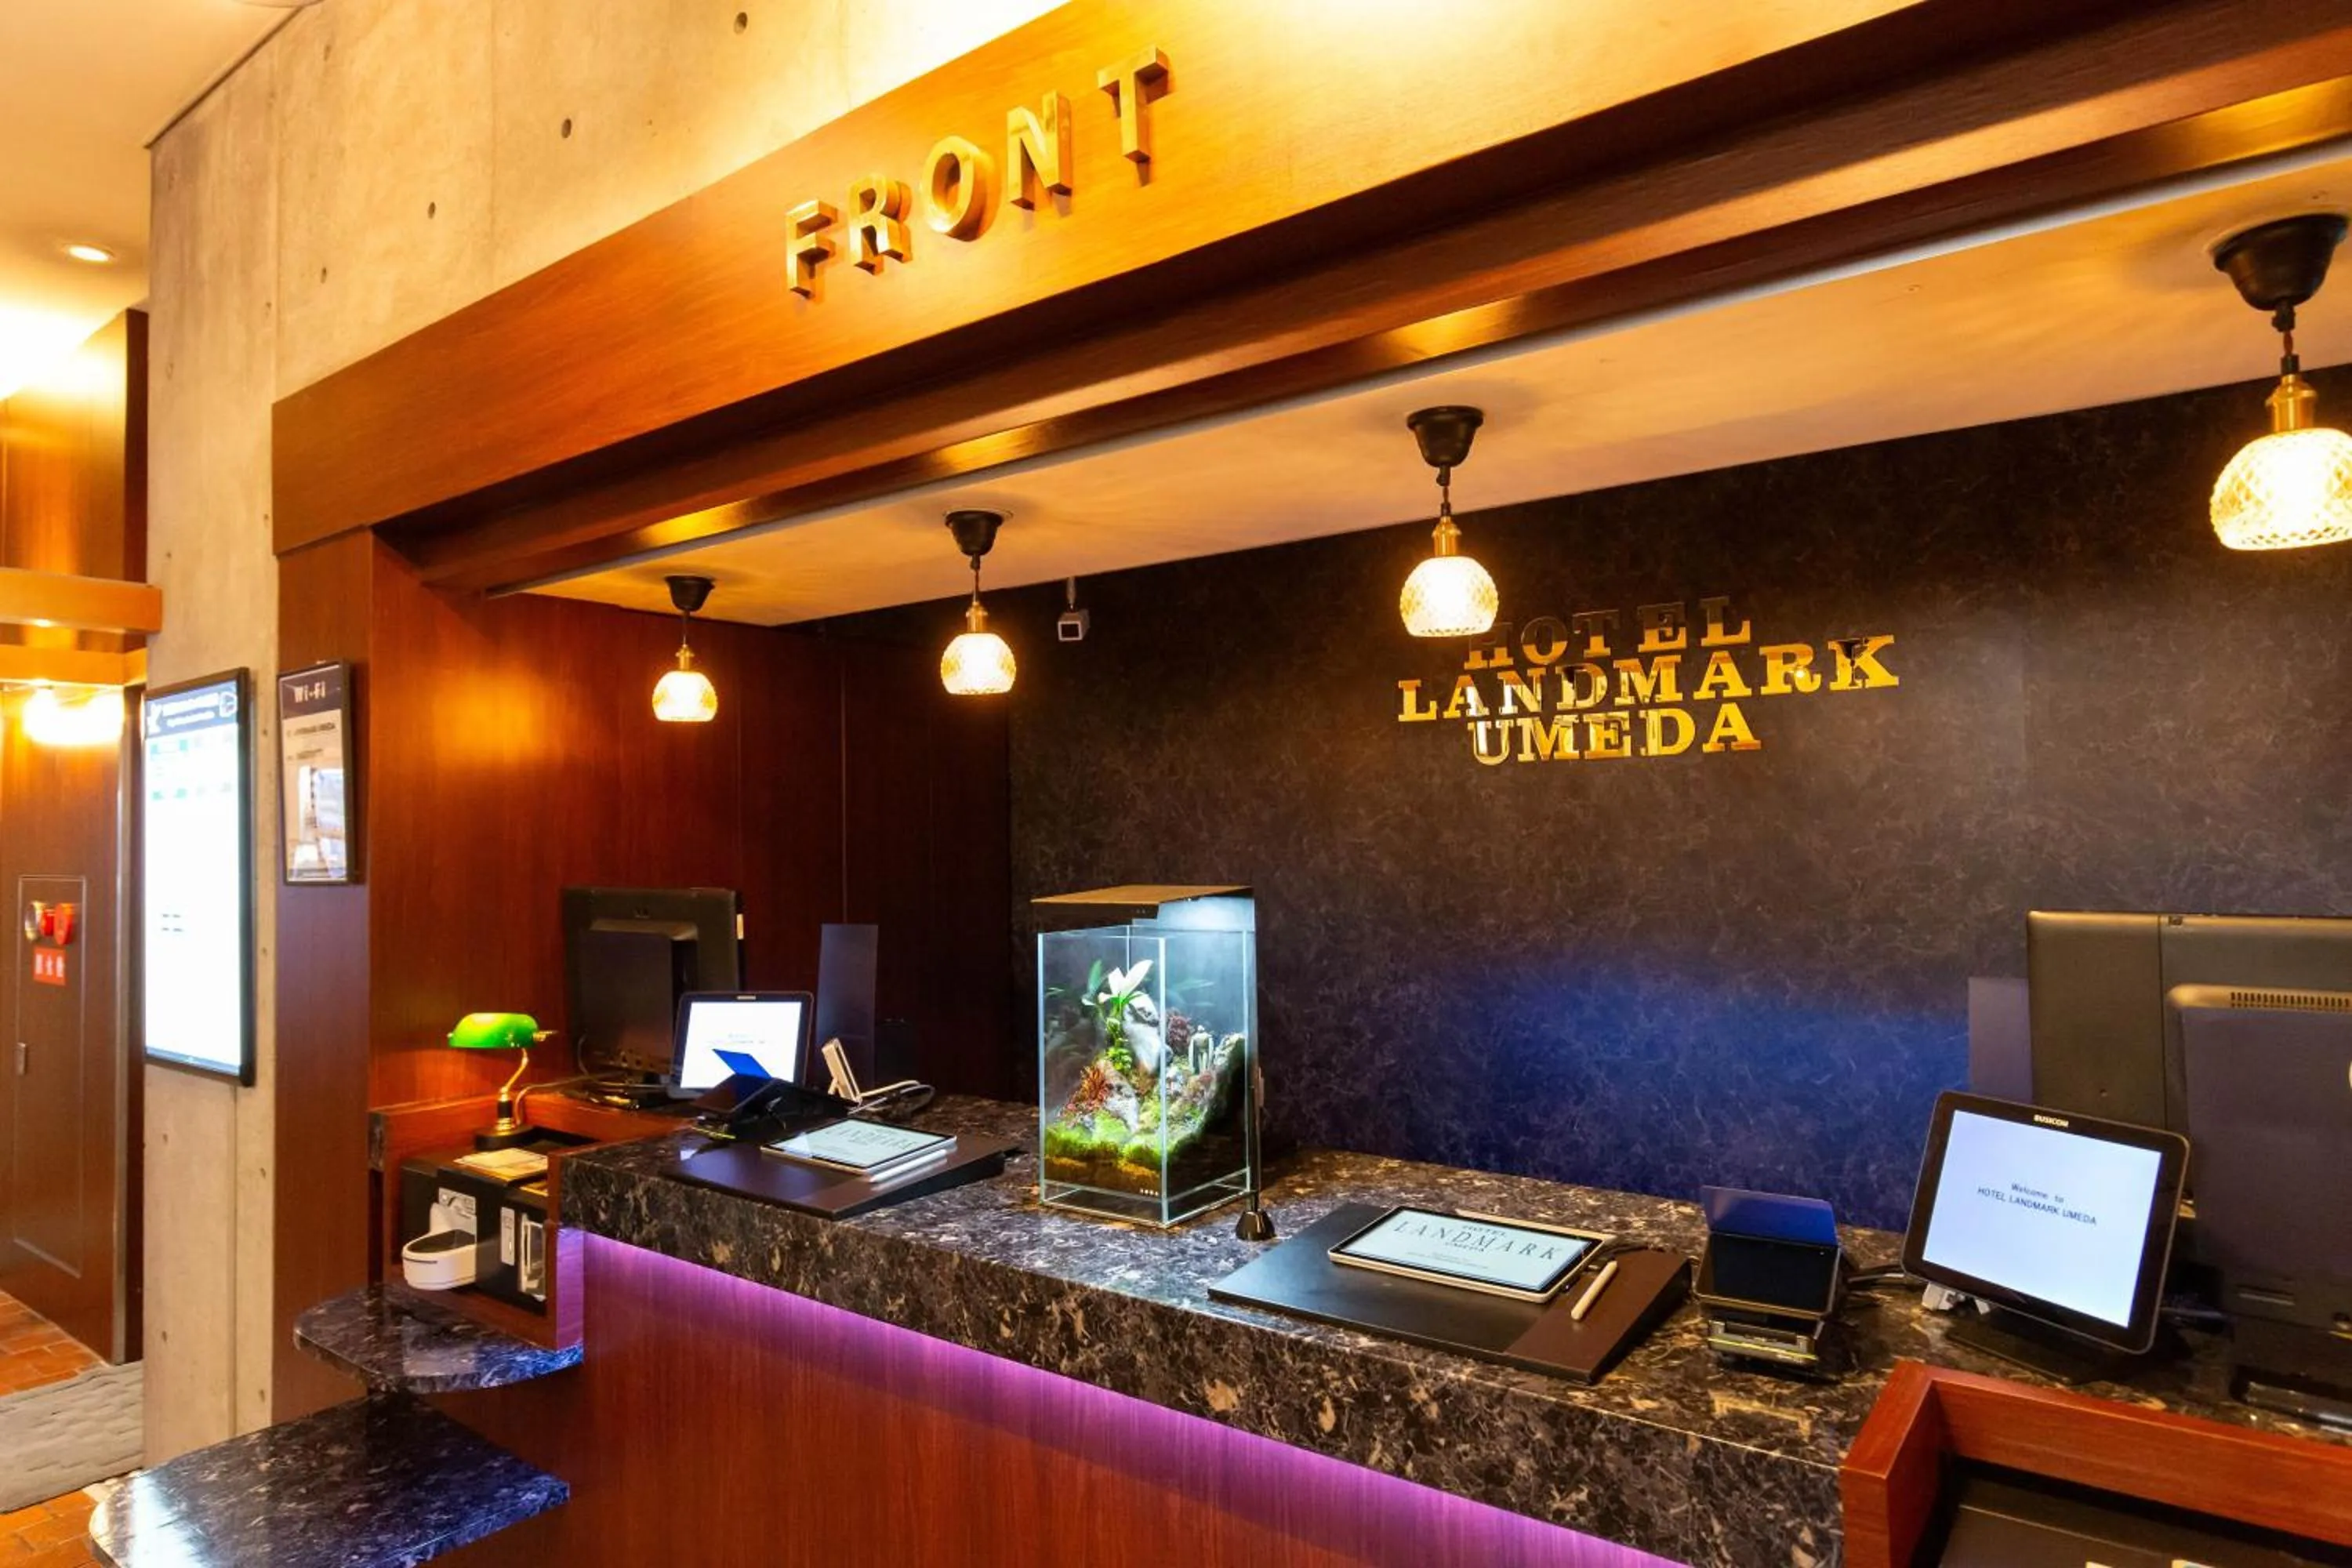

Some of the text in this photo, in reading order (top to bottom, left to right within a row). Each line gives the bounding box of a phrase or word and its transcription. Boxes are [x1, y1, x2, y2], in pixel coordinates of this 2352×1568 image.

[786, 46, 1169, 299] FRONT
[1463, 596, 1751, 670] HOTEL
[293, 681, 326, 703] Wi-Fi
[1398, 633, 1900, 722] LANDMARK
[1467, 702, 1762, 766] UMEDA
[1977, 1187, 2096, 1225] HOTEL LANDMARK UMEDA
[2011, 1183, 2064, 1203] Welcome to
[1393, 1221, 1563, 1261] LANDMARK
